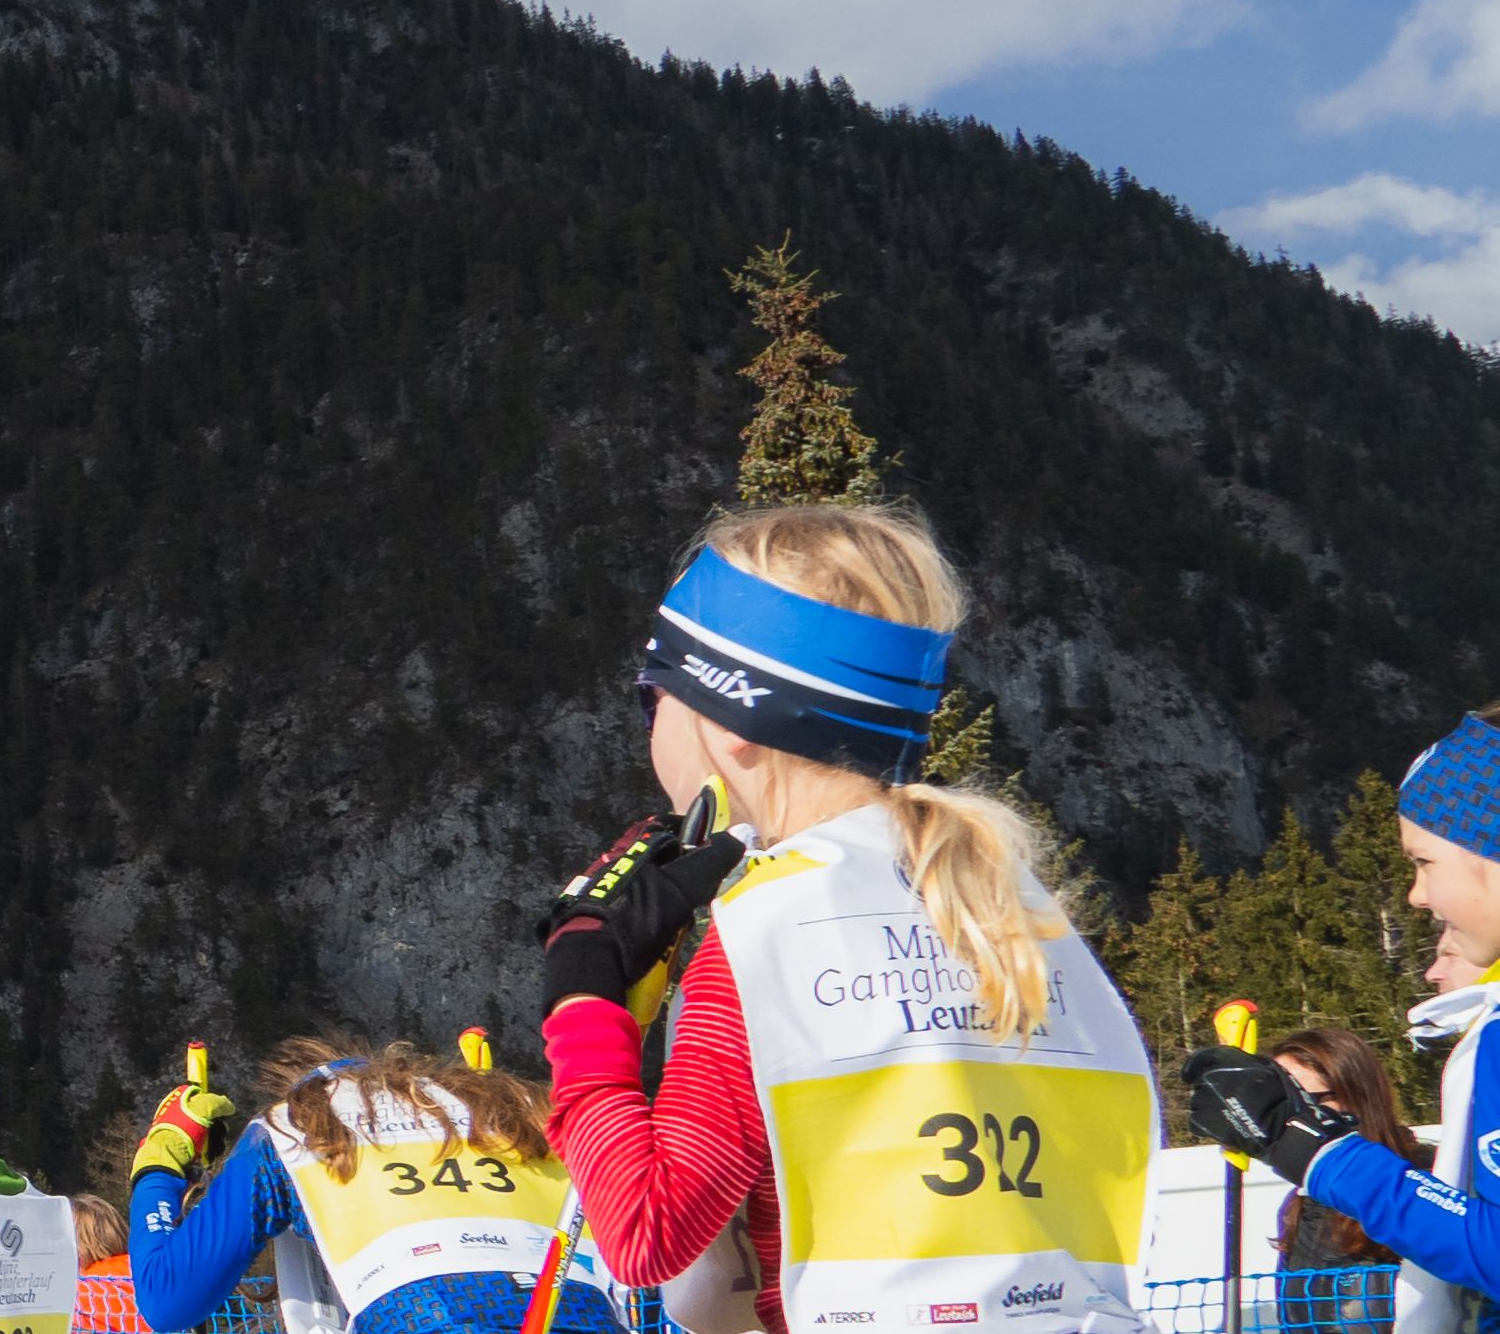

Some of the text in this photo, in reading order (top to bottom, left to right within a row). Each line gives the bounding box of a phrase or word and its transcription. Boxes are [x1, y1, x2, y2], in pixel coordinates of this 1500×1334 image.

[590, 841, 649, 899] LEKI
[382, 1157, 516, 1196] 343
[459, 1233, 509, 1246] Seefeld
[1002, 1281, 1065, 1308] Seefeld
[829, 1312, 876, 1324] TERREX
